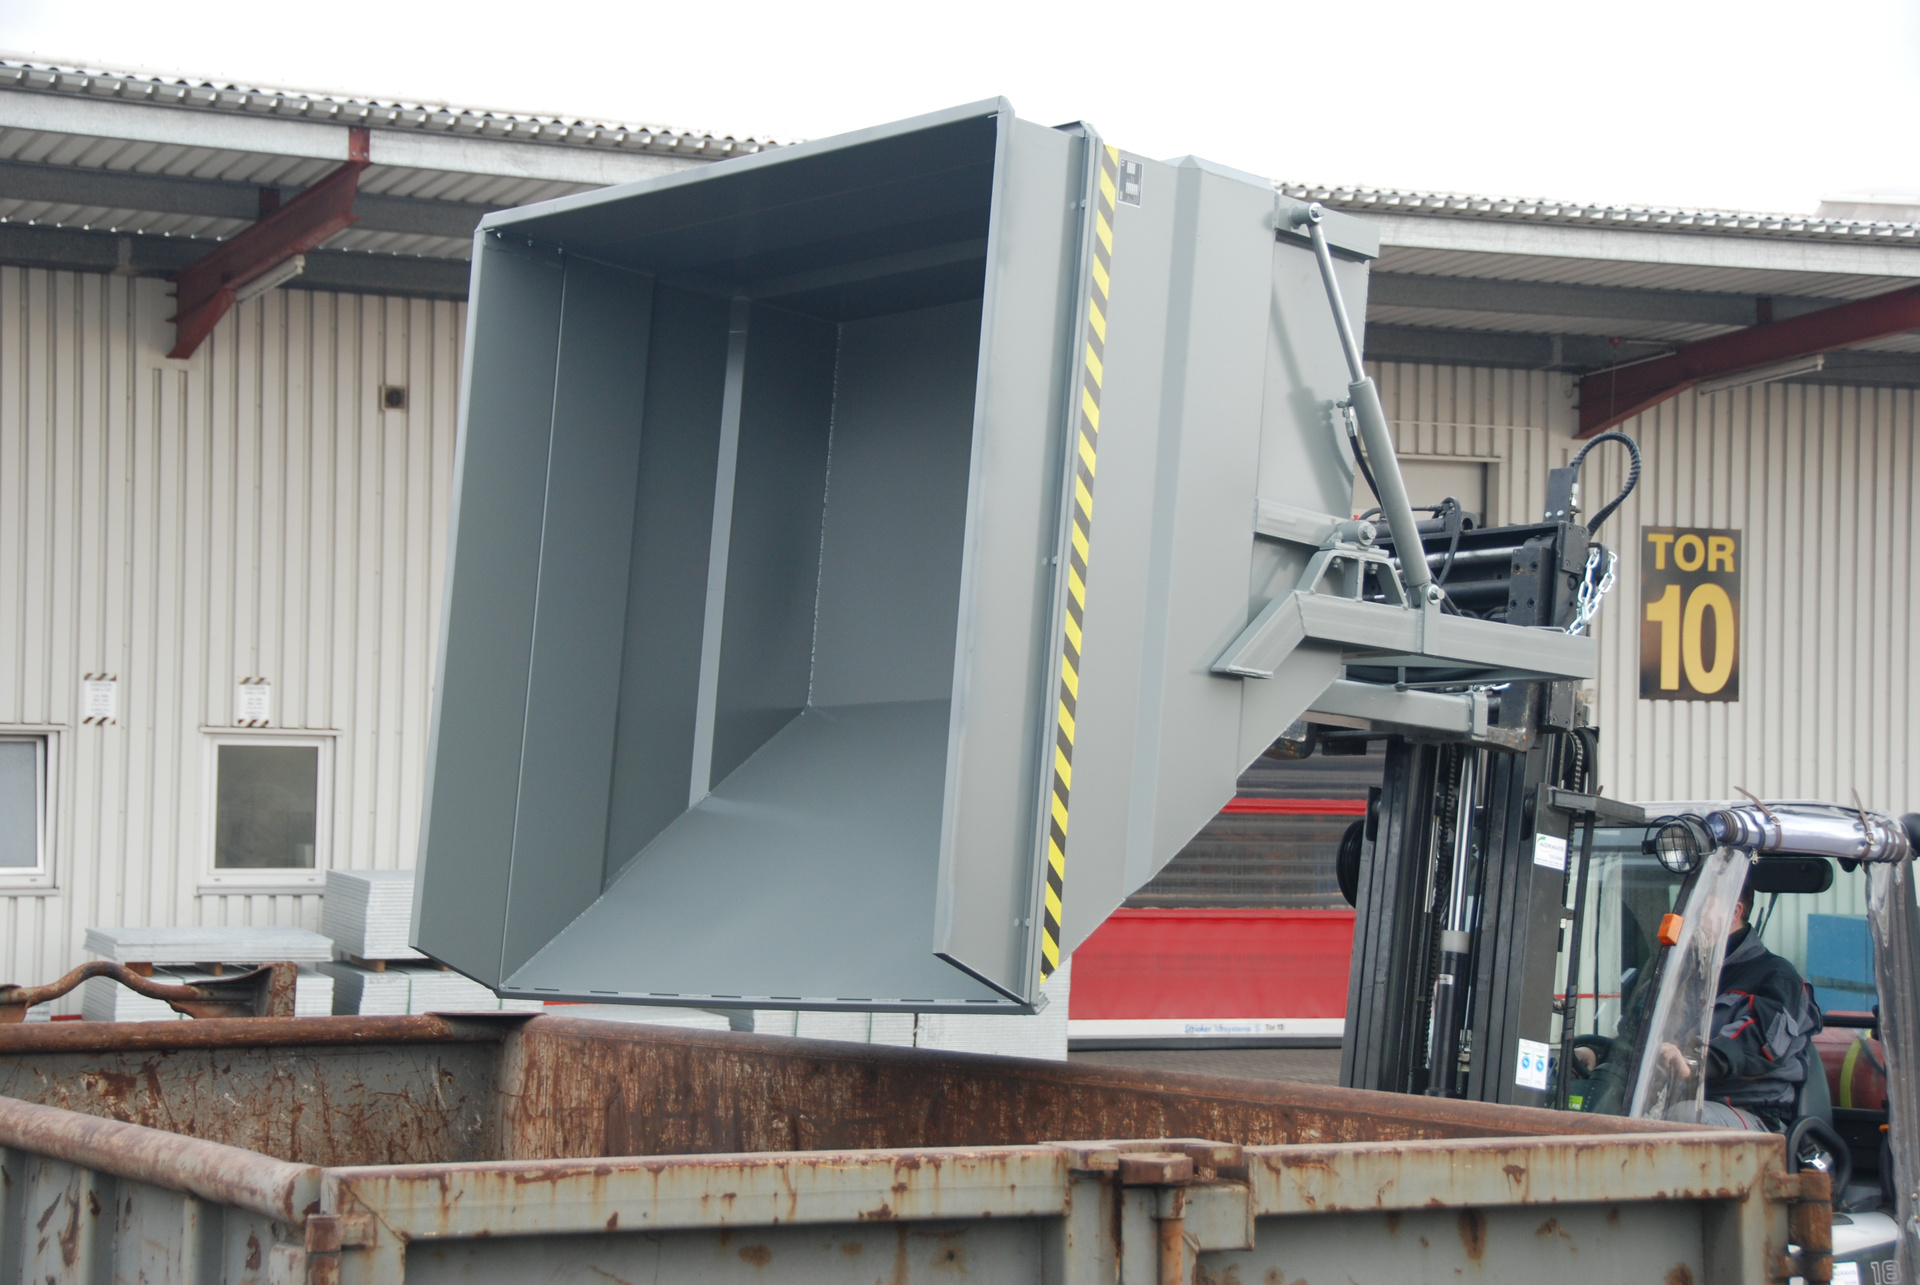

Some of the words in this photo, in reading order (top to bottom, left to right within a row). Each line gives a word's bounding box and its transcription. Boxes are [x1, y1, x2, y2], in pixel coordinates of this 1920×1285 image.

[1647, 533, 1735, 573] TOR
[1646, 583, 1735, 694] 10
[1539, 841, 1565, 852] AGRAVIS
[1265, 1023, 1275, 1031] Tor
[1870, 1260, 1902, 1285] 18
